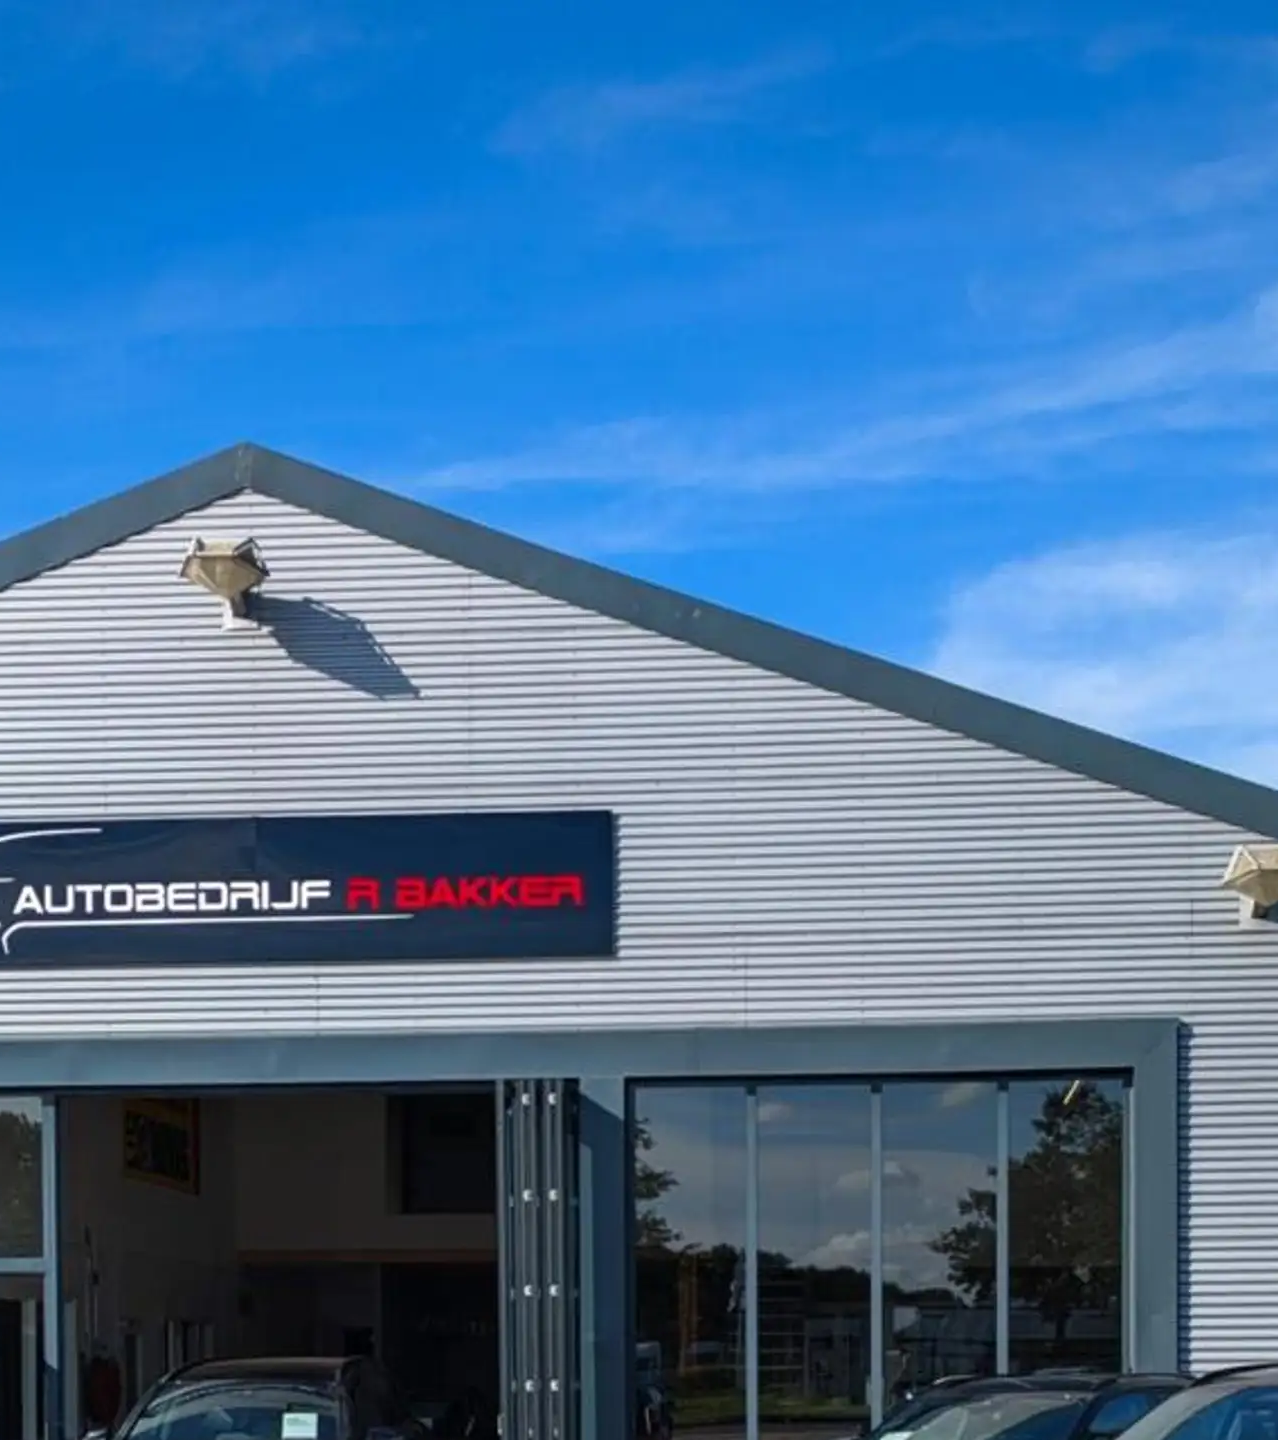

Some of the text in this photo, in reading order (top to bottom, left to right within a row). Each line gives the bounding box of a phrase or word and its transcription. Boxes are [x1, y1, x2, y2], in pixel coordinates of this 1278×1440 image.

[13, 874, 584, 915] AUTOBEDRIJF R BAKKER
